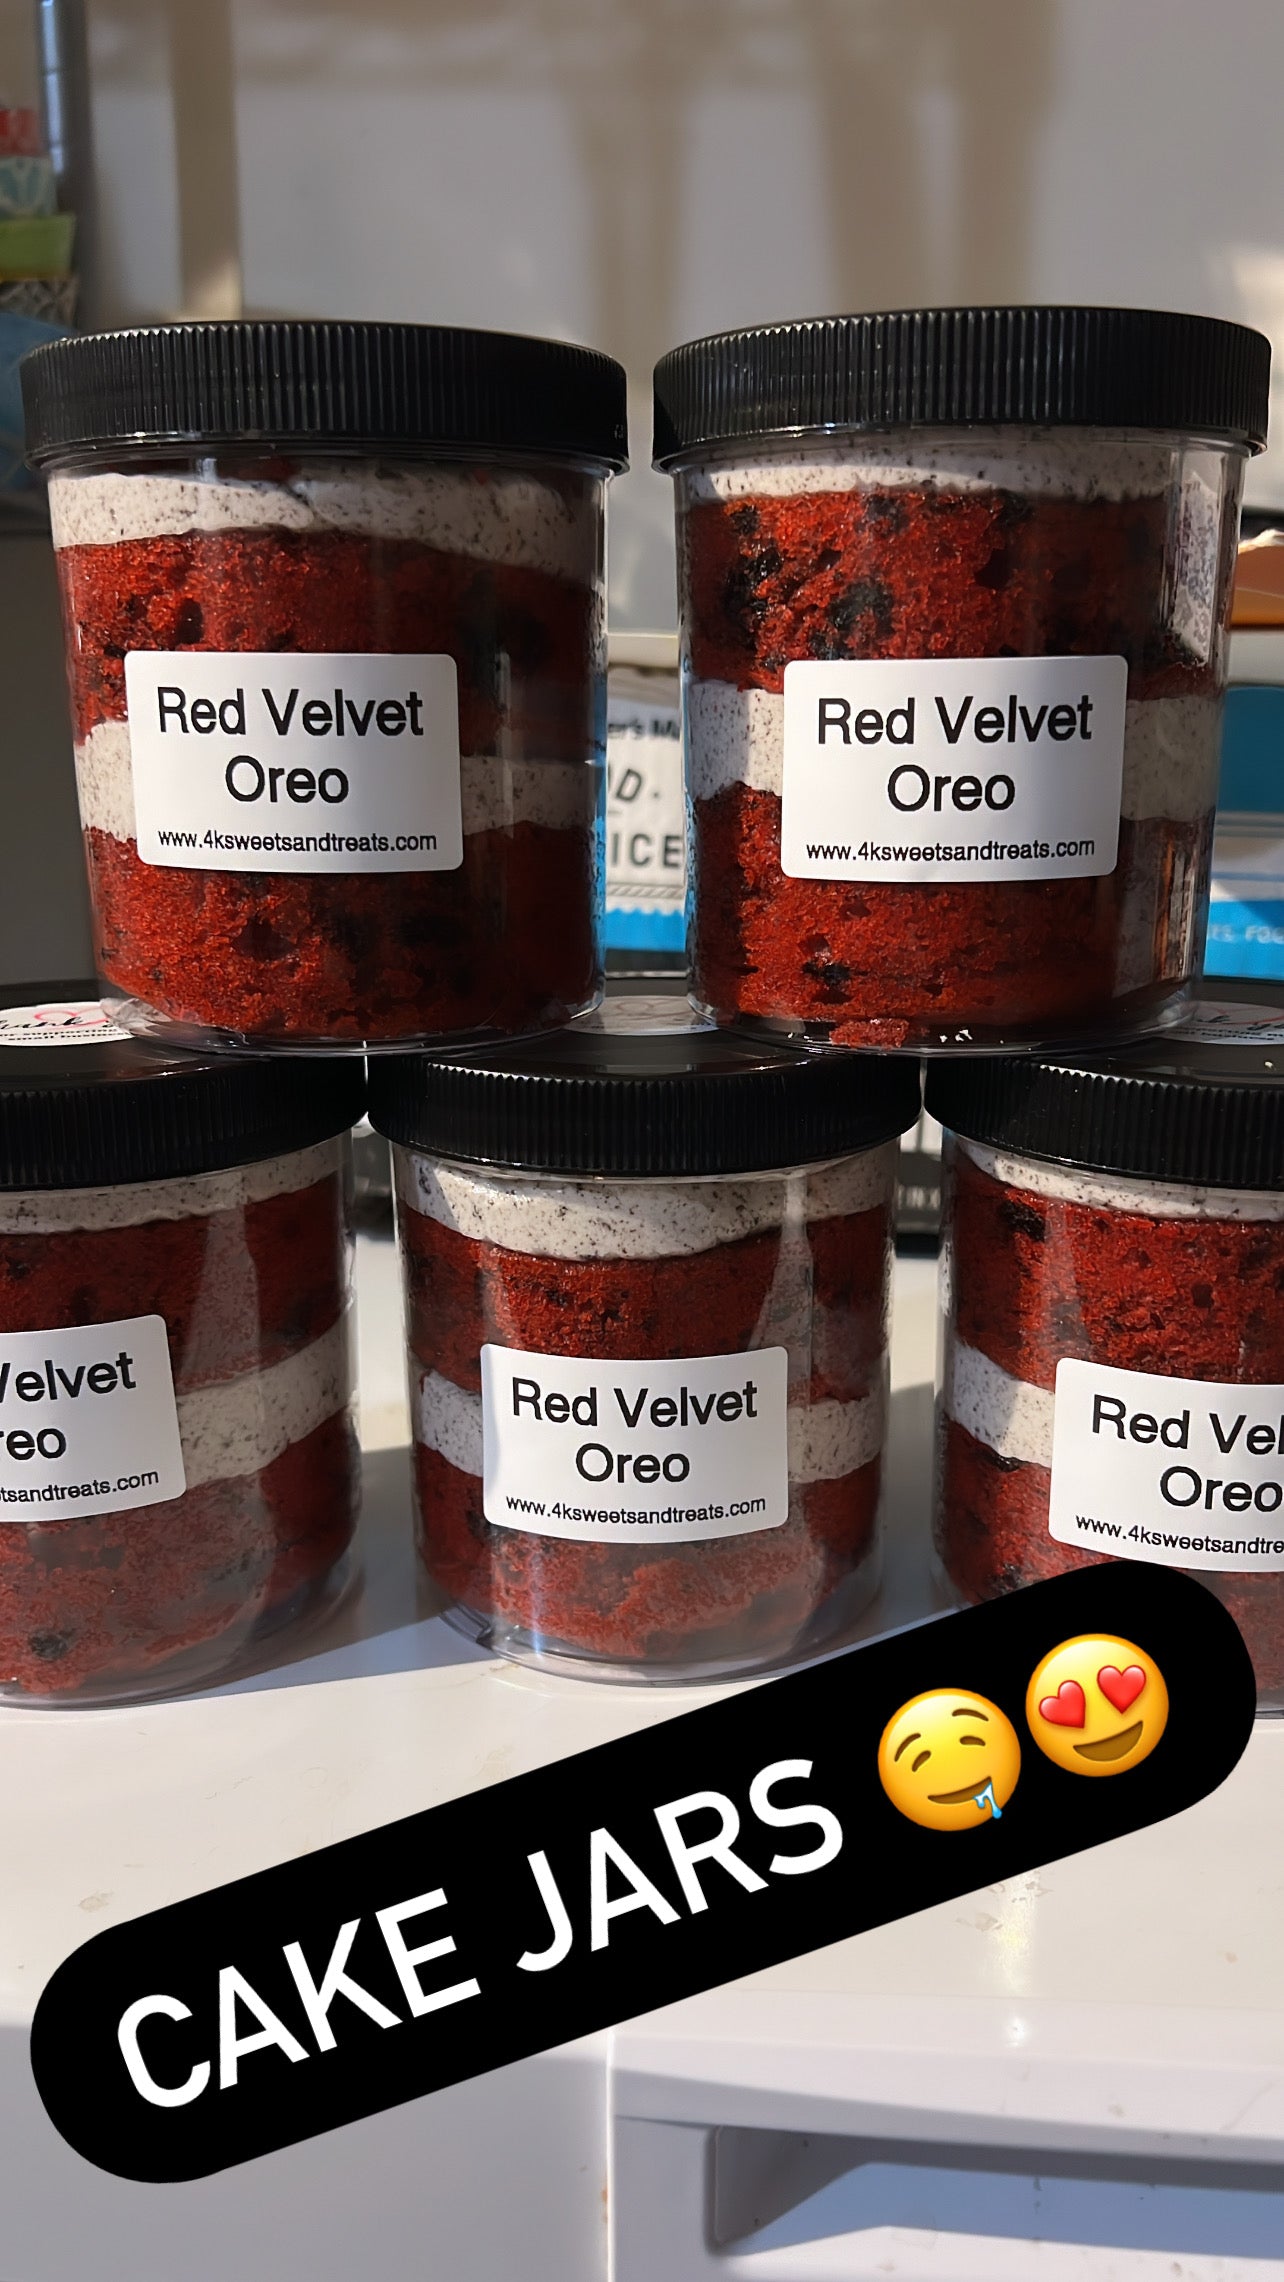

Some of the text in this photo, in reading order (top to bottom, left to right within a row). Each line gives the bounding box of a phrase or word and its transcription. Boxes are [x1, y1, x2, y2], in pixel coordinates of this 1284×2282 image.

[157, 686, 425, 737] Red Velvet
[818, 694, 1094, 746] Red Velvet
[225, 755, 350, 804] Oreo
[887, 764, 1016, 812] Oreo
[158, 829, 438, 852] www.4ksweetsandtreats.com
[806, 838, 1095, 862] www.4ksweetsandtreats.com
[512, 1376, 758, 1428] Red Velvet
[1092, 1394, 1284, 1456] Red Vel
[0, 1471, 159, 1503] tsandtreats.com
[575, 1442, 690, 1484] Oreo
[506, 1496, 766, 1525] www.4ksweetsandtreats.com
[1159, 1465, 1283, 1513] Oreo
